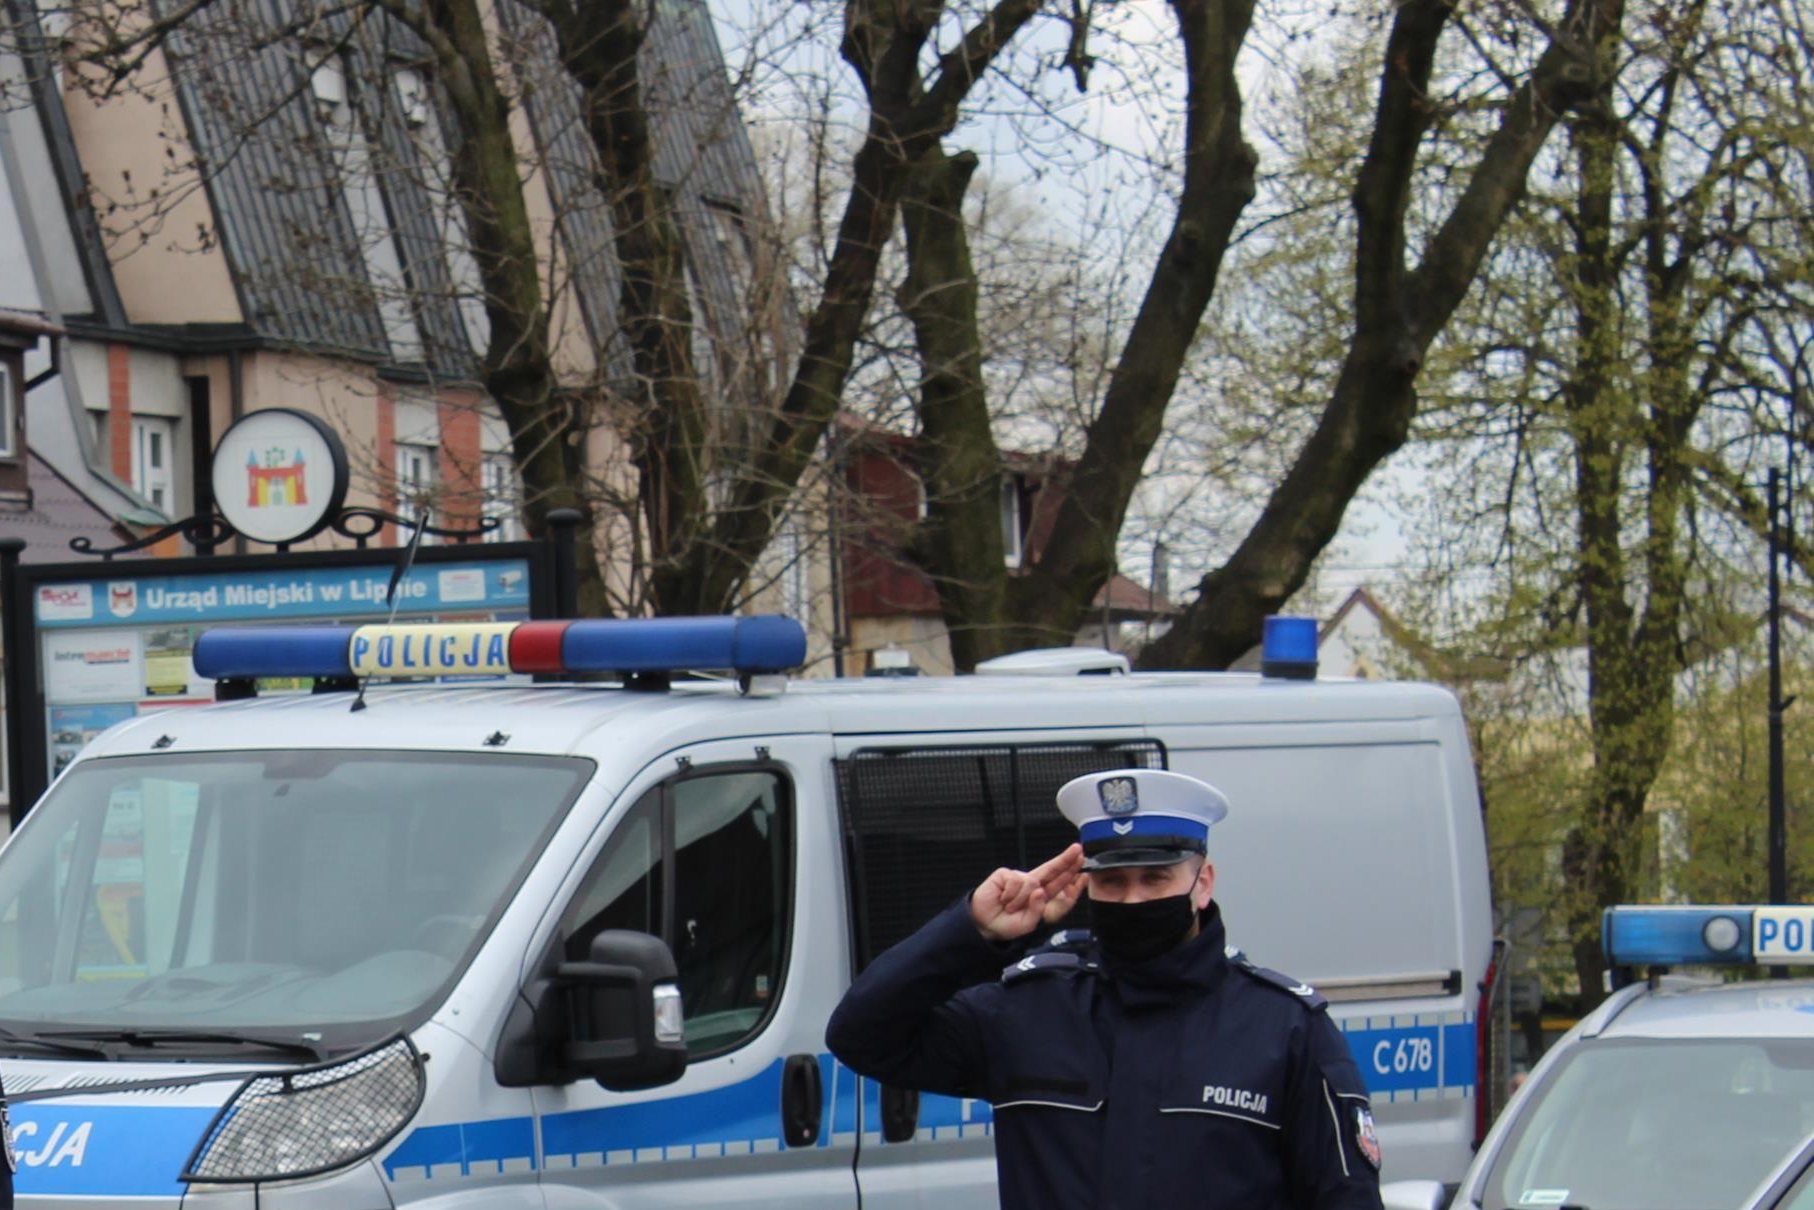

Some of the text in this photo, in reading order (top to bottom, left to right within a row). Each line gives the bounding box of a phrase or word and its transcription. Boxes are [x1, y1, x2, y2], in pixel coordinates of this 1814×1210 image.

[145, 586, 218, 612] Urząd
[223, 581, 314, 609] Miejski
[319, 585, 343, 601] w
[353, 633, 505, 668] POLICJA
[1759, 918, 1814, 952] PO
[1393, 1037, 1432, 1072] 678
[1202, 1085, 1268, 1114] POLICJA
